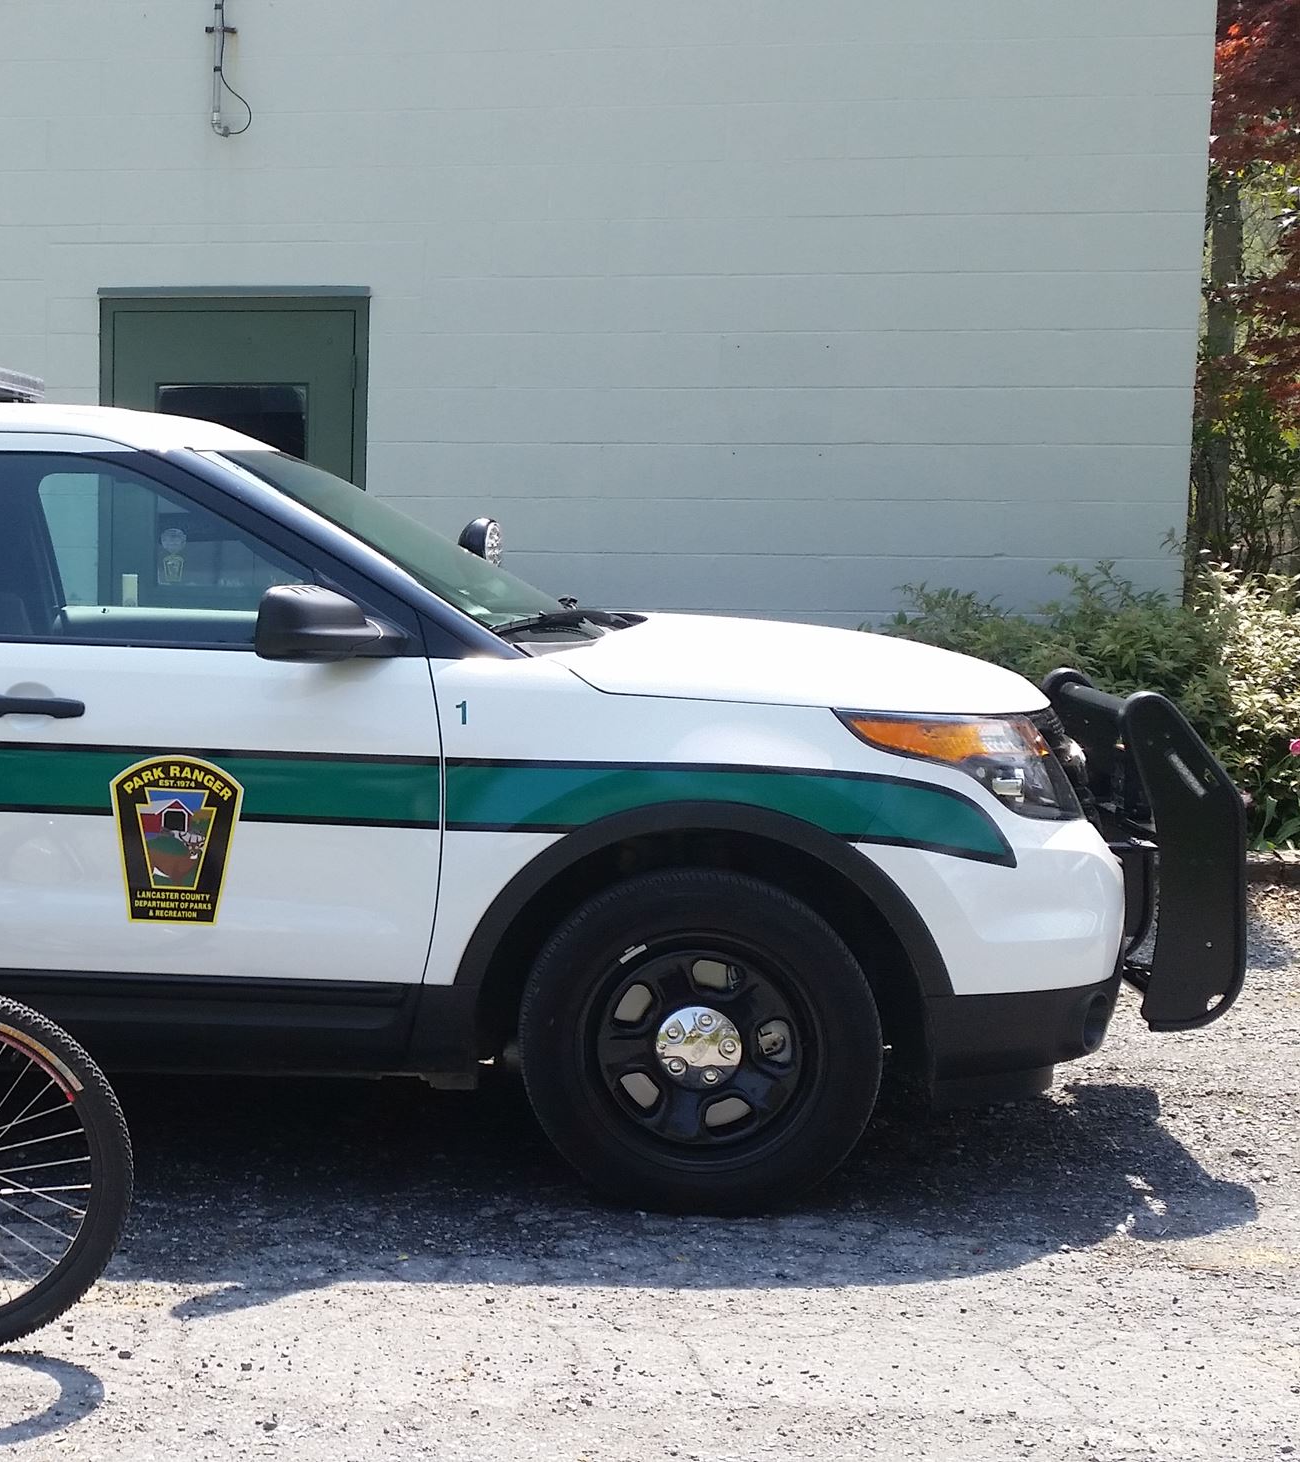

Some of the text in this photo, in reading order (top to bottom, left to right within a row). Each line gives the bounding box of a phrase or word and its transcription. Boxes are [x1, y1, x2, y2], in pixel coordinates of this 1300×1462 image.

[455, 700, 467, 725] 1
[123, 765, 233, 801] PARK RANGER
[136, 890, 211, 901] LANCASTER COUNTY
[134, 899, 180, 909] DEPARTMENT
[189, 902, 212, 910] PARKS
[155, 909, 198, 918] RECREATION
